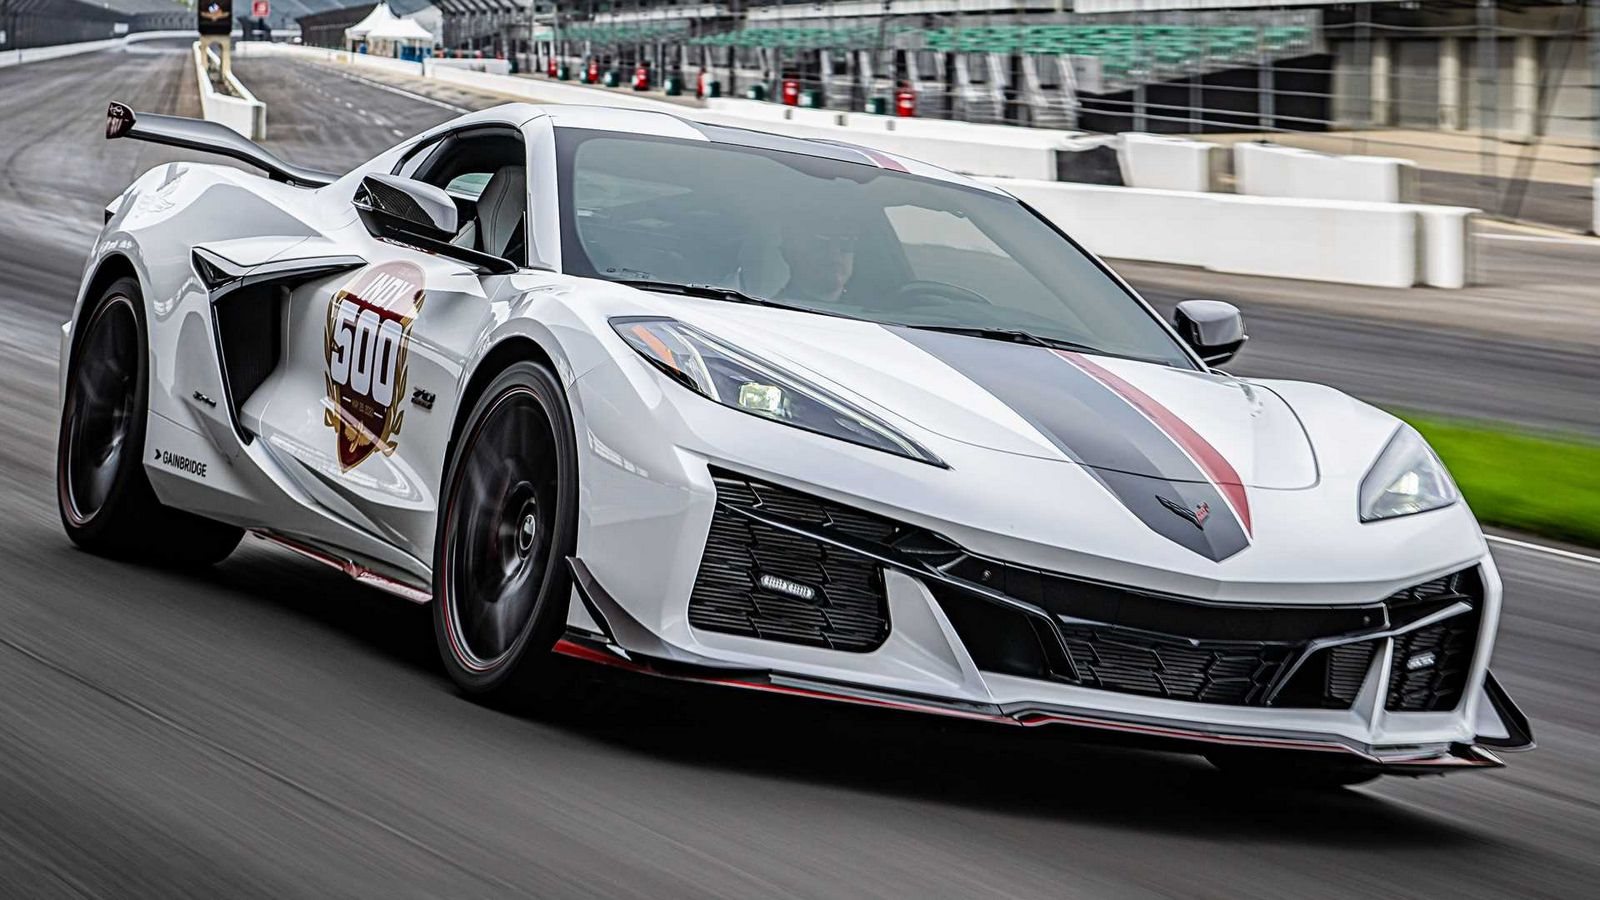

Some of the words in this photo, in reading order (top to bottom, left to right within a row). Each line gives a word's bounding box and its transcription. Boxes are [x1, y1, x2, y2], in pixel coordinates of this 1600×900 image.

[357, 272, 415, 311] INDY
[331, 299, 403, 407] 500
[162, 450, 208, 478] GAINBRIDGE
